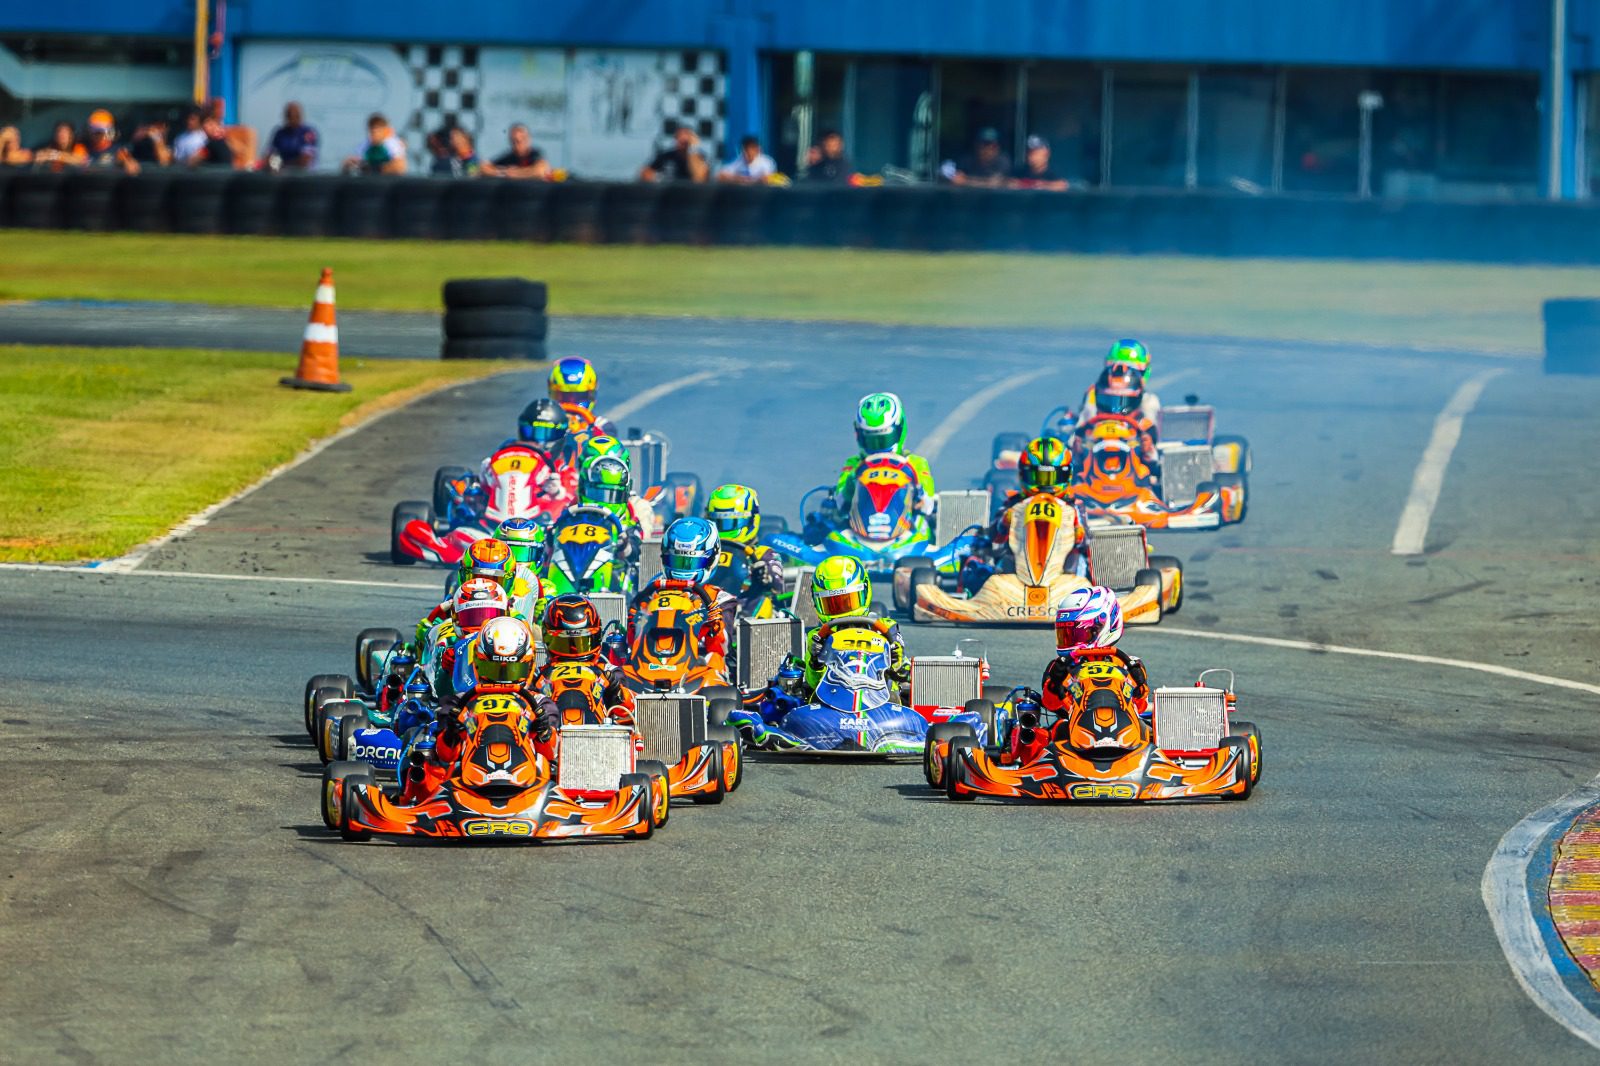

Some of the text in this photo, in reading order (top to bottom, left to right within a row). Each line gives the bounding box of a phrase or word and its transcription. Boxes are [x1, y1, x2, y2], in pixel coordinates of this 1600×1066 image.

[1030, 503, 1055, 517] 46
[569, 526, 597, 537] 18
[658, 597, 670, 607] 8
[554, 665, 582, 677] 21
[1087, 665, 1114, 675] 57
[482, 698, 511, 710] 97
[1073, 785, 1133, 799] CRG
[467, 821, 530, 836] CRG
